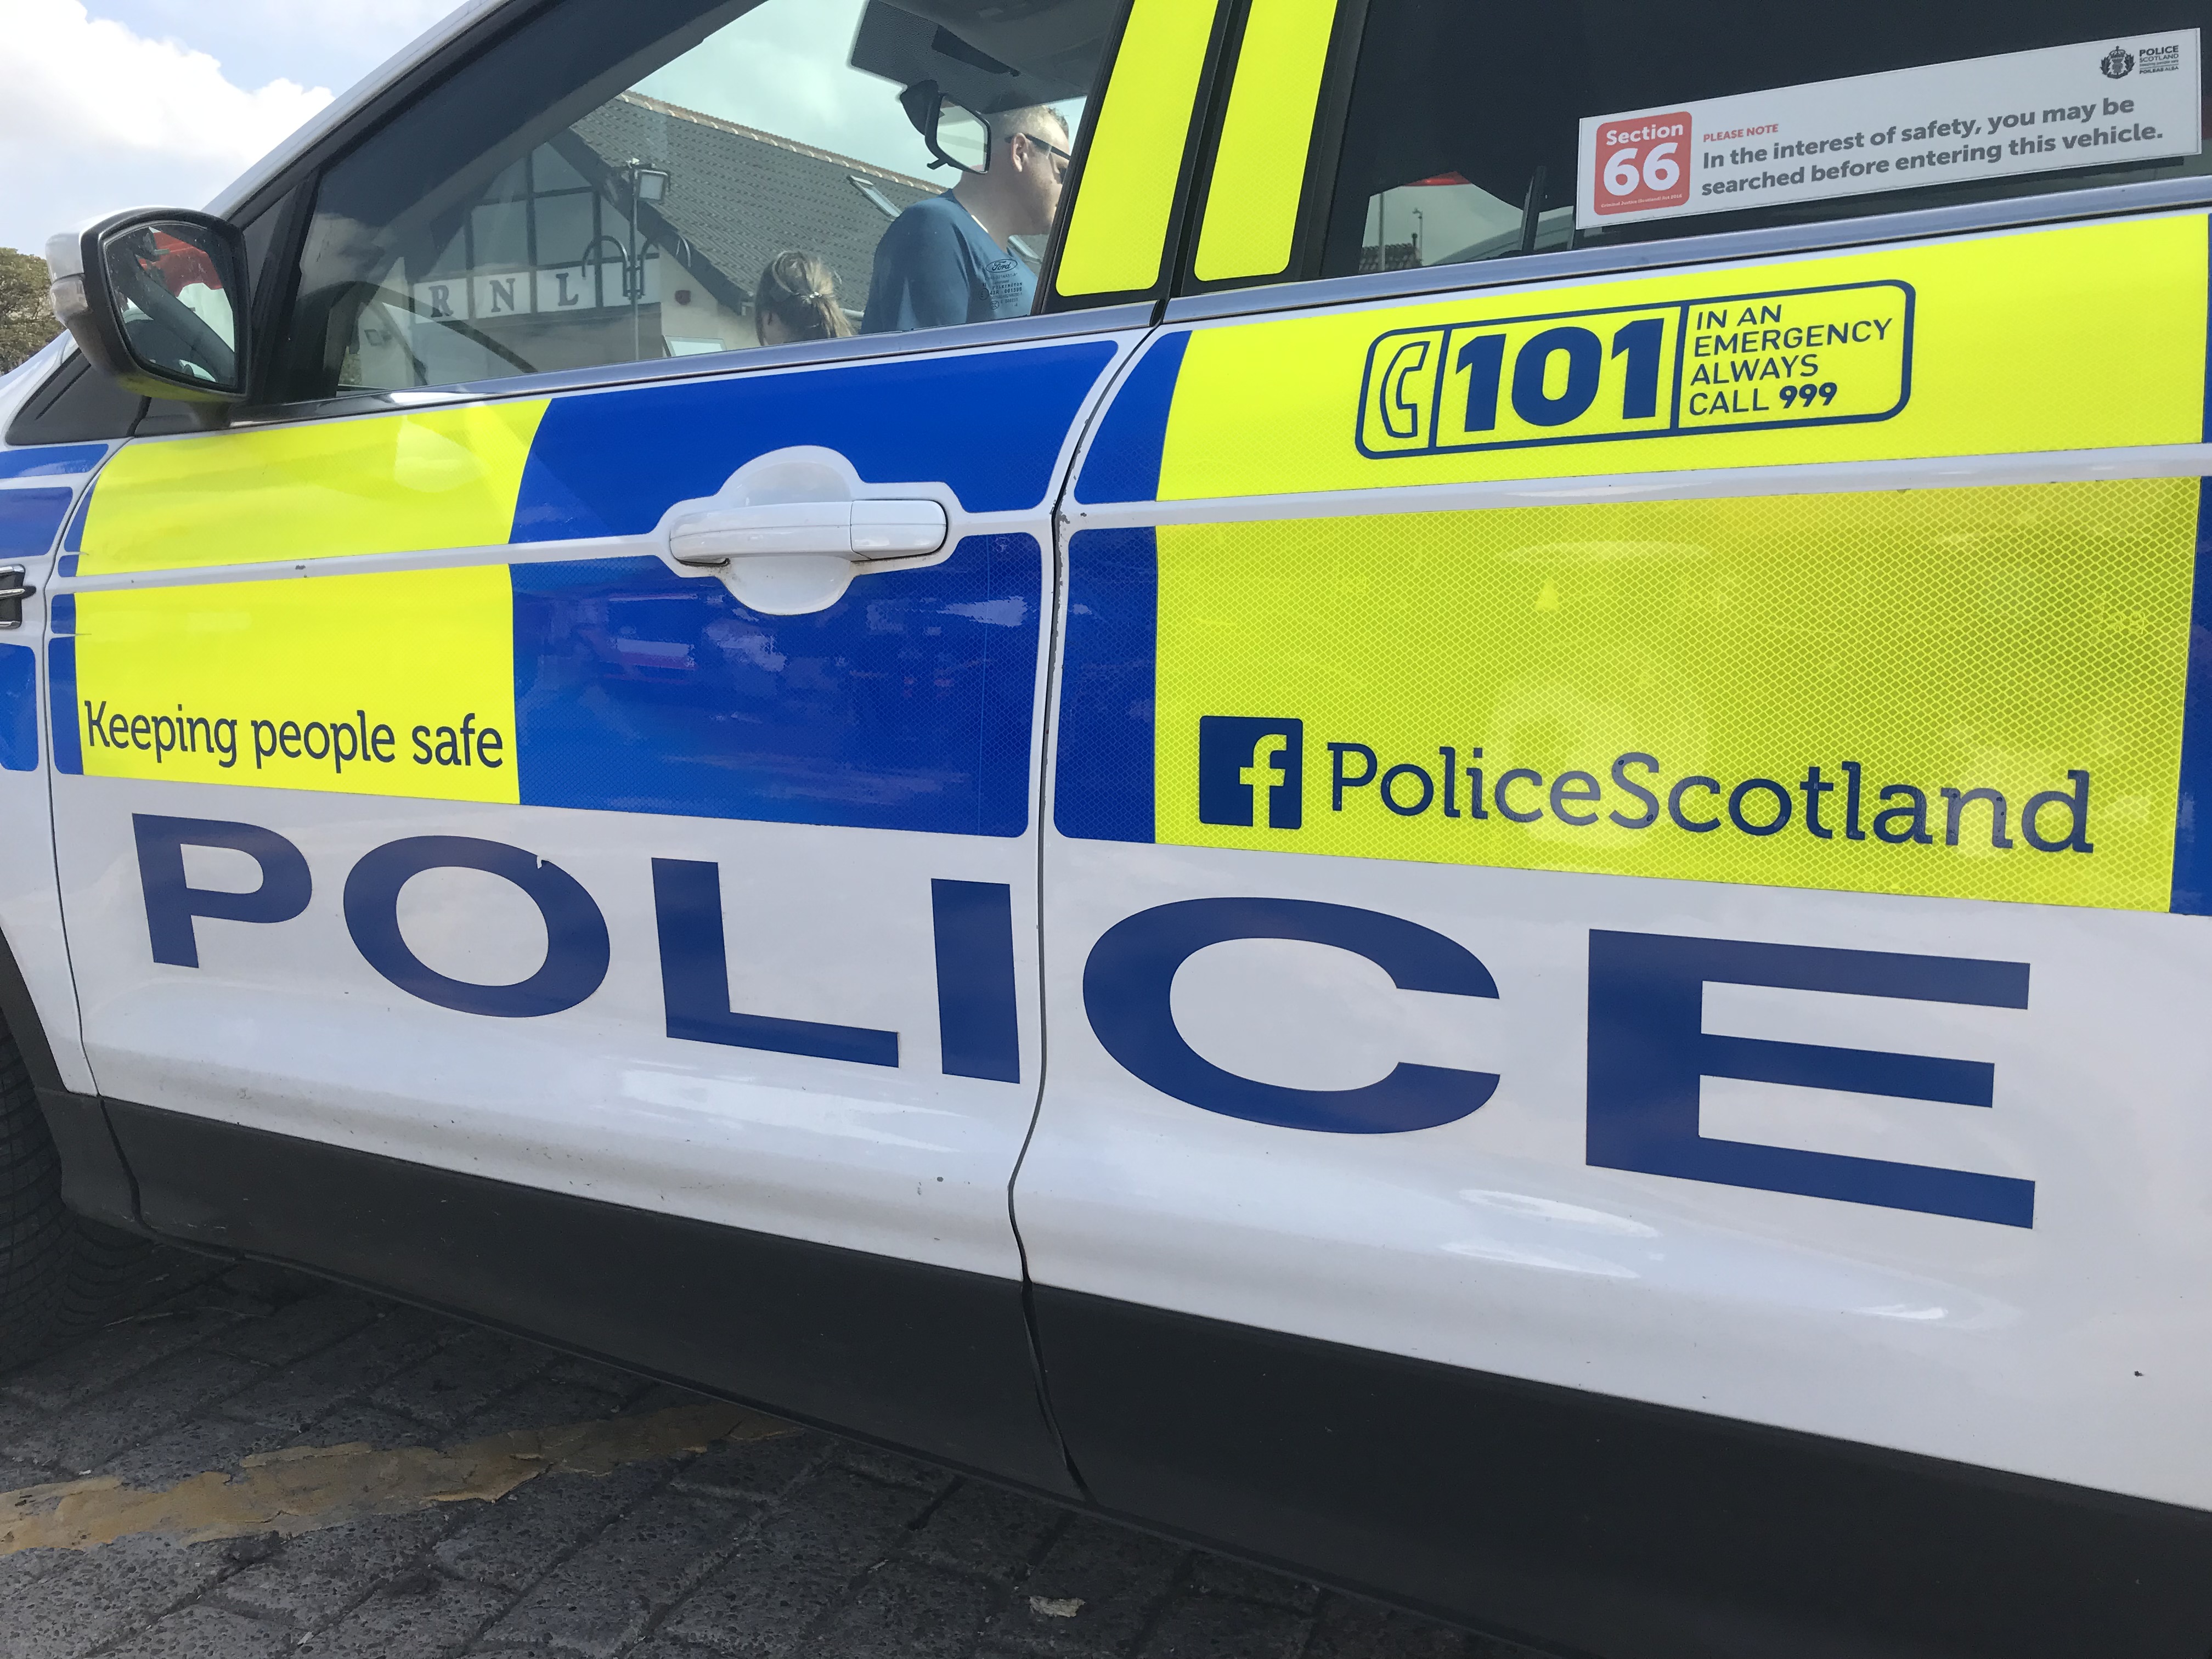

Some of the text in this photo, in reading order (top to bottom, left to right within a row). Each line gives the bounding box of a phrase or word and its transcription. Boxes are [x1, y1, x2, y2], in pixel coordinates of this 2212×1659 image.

[2140, 45, 2179, 57] POLICE
[2140, 54, 2179, 63] SCOTLAND
[1606, 122, 1683, 146] Section
[1703, 123, 1779, 142] PLEASE NOTE
[1703, 98, 2135, 169] In the interest of safety, you may be
[1604, 142, 1679, 196] 66
[1702, 123, 2163, 196] searched before entering this vehicle.
[992, 261, 1011, 271] Ford
[1696, 304, 1782, 330] IN AN
[1694, 318, 1892, 357] EMERGENCY
[1455, 318, 1665, 432] 101
[1690, 354, 1818, 386] ALWAYS
[1689, 382, 1837, 416] CALL 999
[84, 701, 503, 773] Keeping people safe
[1327, 741, 2094, 853] PoliceScotland
[132, 812, 2035, 1229] POLICE
